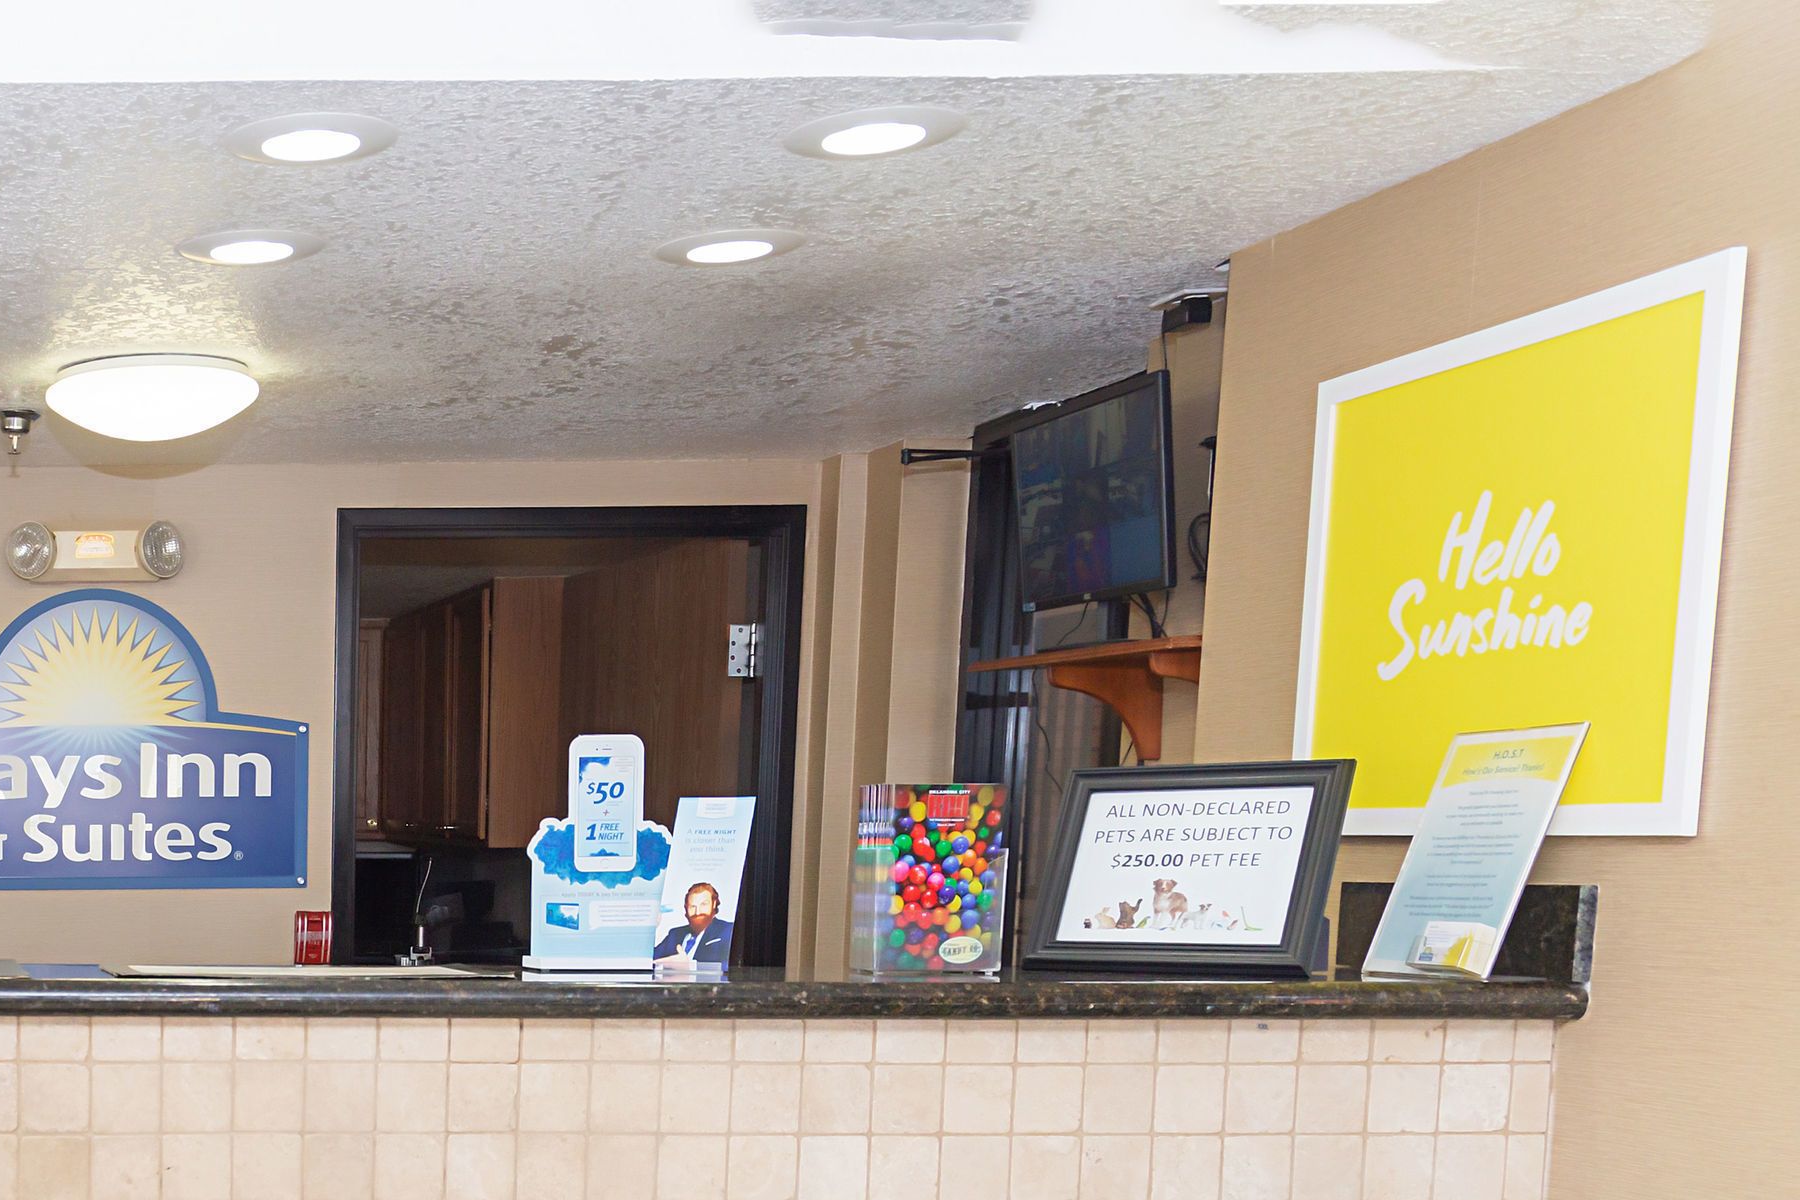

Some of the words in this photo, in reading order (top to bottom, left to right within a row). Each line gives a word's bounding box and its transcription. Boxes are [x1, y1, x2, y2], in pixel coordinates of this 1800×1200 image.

[1438, 489, 1561, 590] Hello
[1377, 577, 1593, 681] Sunshine
[139, 742, 272, 799] Inn
[586, 781, 625, 804] $50
[1106, 804, 1136, 818] ALL
[1142, 800, 1291, 817] NON-DECLARED
[586, 823, 597, 840] 1
[600, 822, 620, 831] FREE
[598, 832, 624, 840] NIGHT
[1094, 829, 1135, 844] PETS
[1140, 828, 1176, 842] ARE
[1180, 826, 1261, 842] SUBJECT
[1267, 826, 1293, 840] TO
[1111, 853, 1184, 870] $250.00
[1189, 853, 1224, 867] PET
[1228, 852, 1262, 867] FEE
